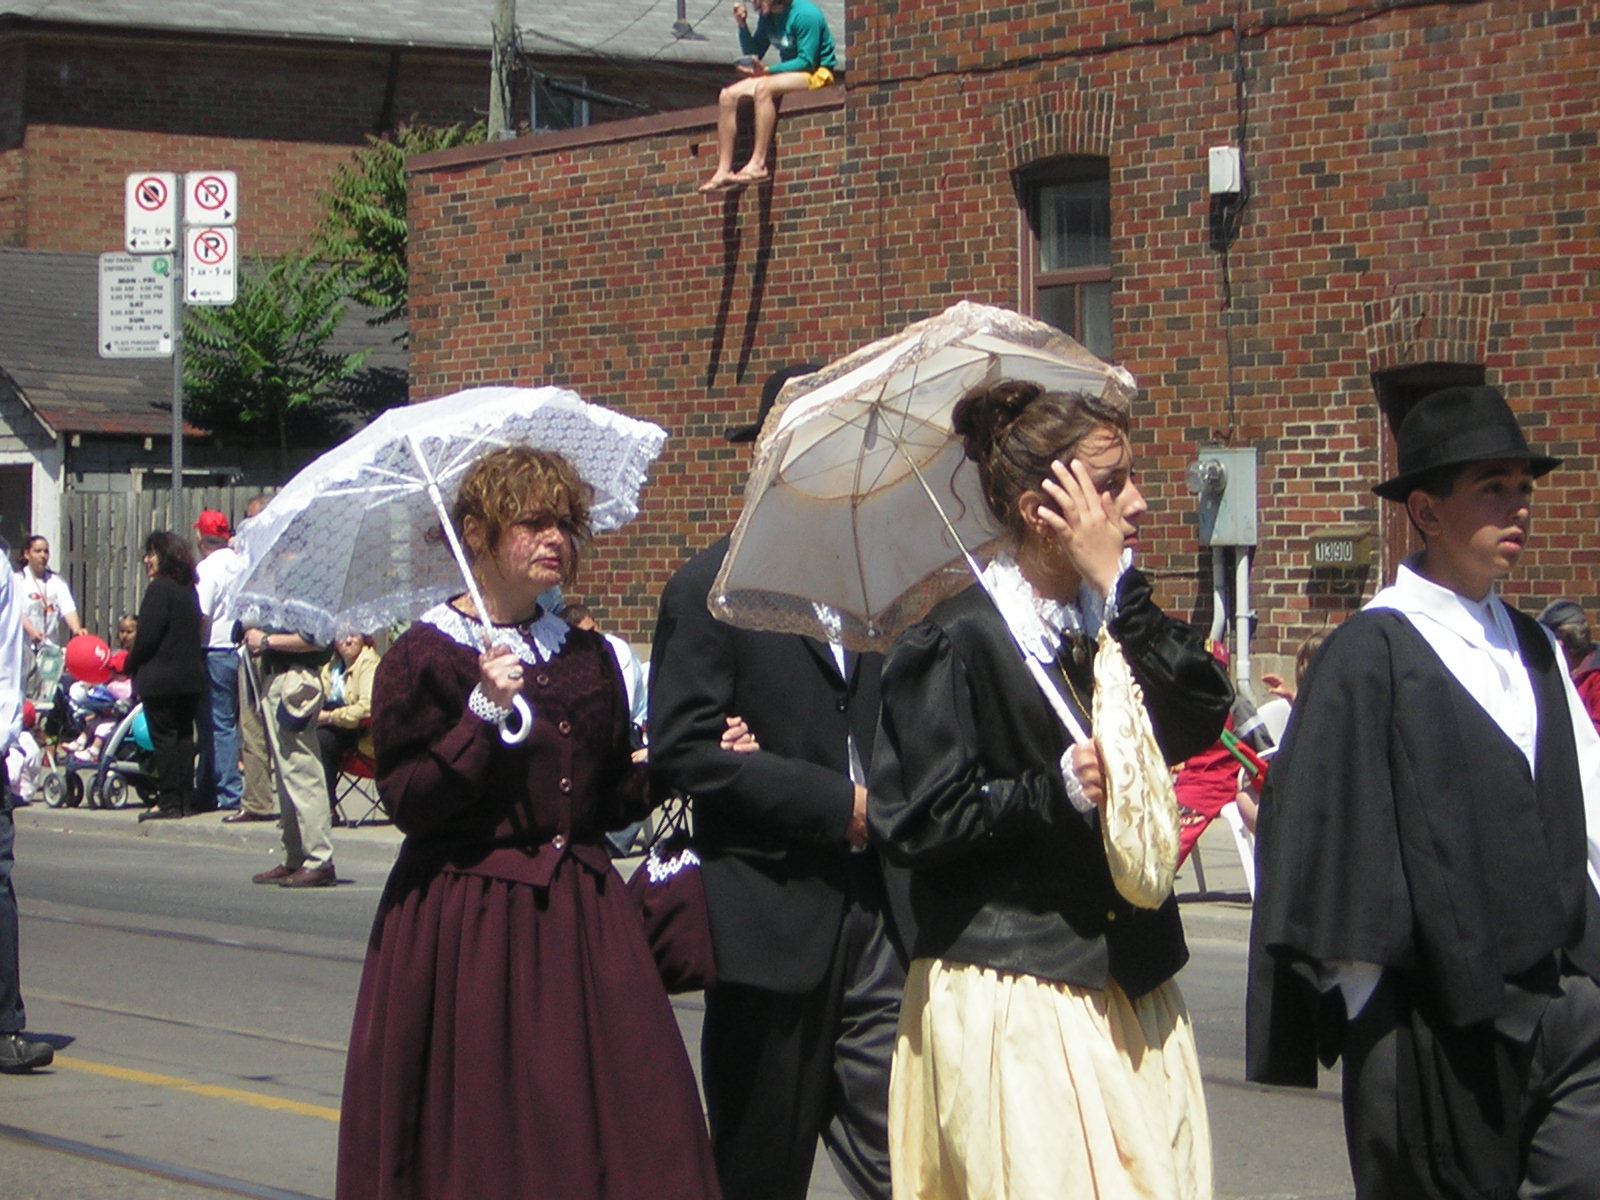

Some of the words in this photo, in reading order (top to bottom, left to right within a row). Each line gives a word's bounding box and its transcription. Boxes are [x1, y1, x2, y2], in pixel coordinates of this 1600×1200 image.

[204, 184, 219, 202] P
[204, 237, 220, 258] P
[1316, 541, 1352, 561] 1390
